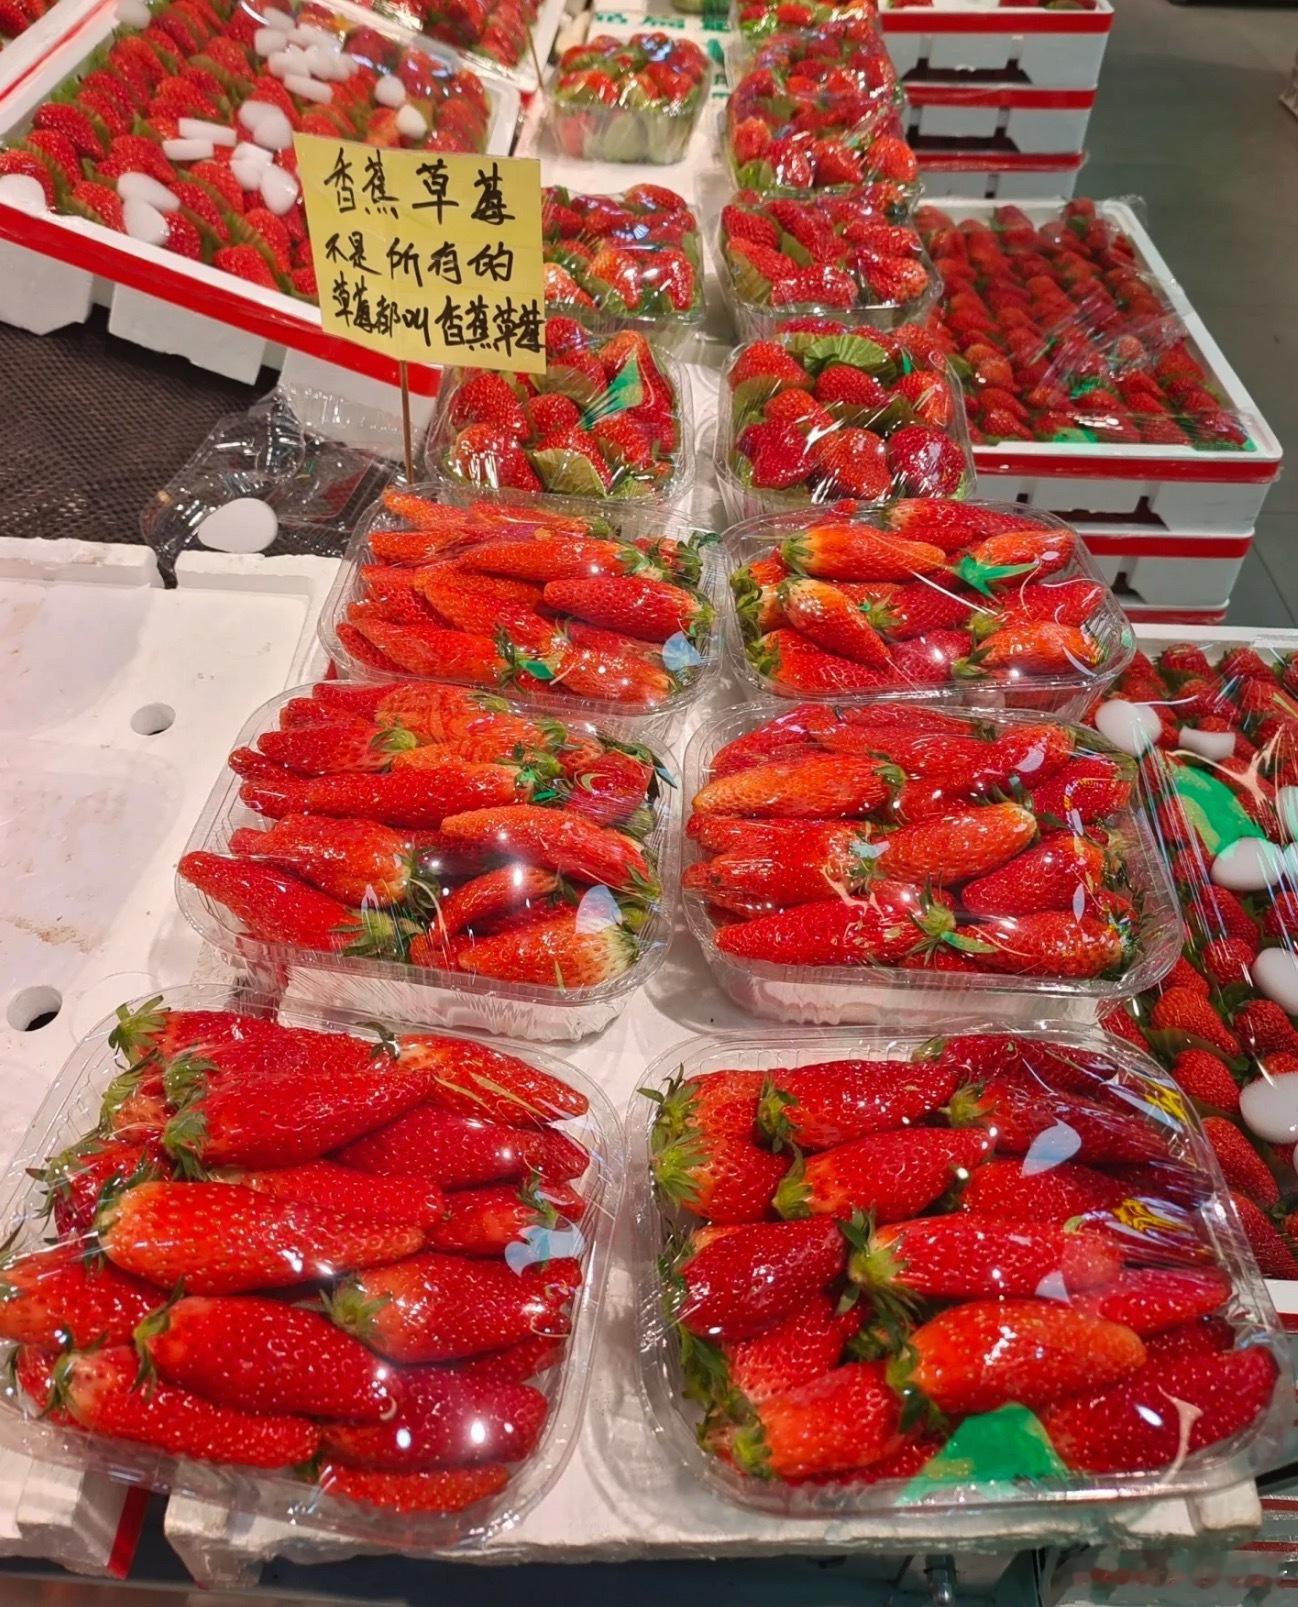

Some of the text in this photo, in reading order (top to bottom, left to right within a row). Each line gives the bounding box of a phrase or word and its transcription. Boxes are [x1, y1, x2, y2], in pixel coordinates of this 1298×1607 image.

[324, 147, 516, 225] 香蕉草莓
[325, 231, 513, 287] 不是所有的
[332, 270, 546, 357] 草莓都叫香蕉草莓
